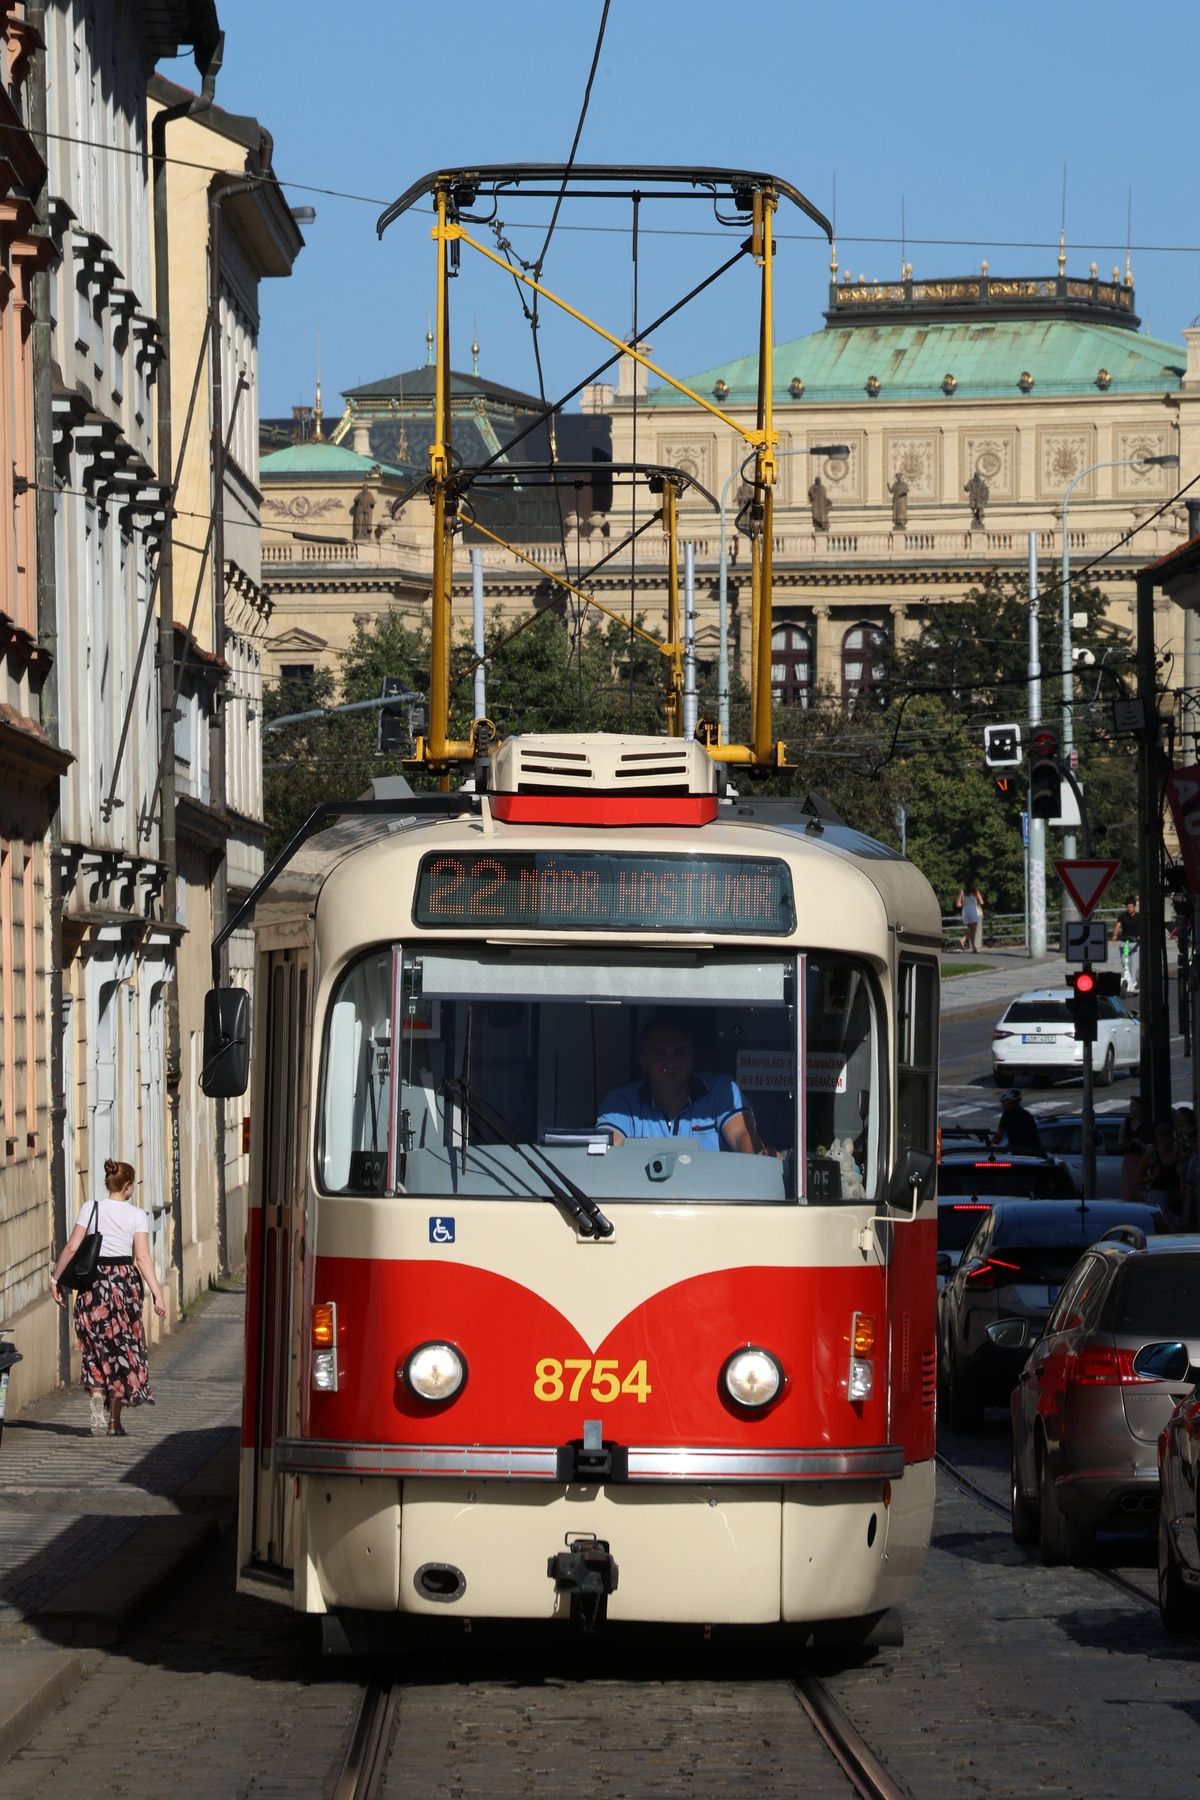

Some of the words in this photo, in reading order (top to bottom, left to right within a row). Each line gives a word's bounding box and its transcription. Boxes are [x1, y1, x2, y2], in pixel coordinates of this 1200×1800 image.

[429, 858, 506, 916] 22
[519, 861, 607, 912] NÁDR.
[618, 866, 773, 917] HOSTIVAŘ
[740, 1056, 785, 1069] MANIPULACE
[740, 1074, 754, 1086] JEN
[755, 1075, 764, 1086] SE
[533, 1357, 652, 1403] 8754
